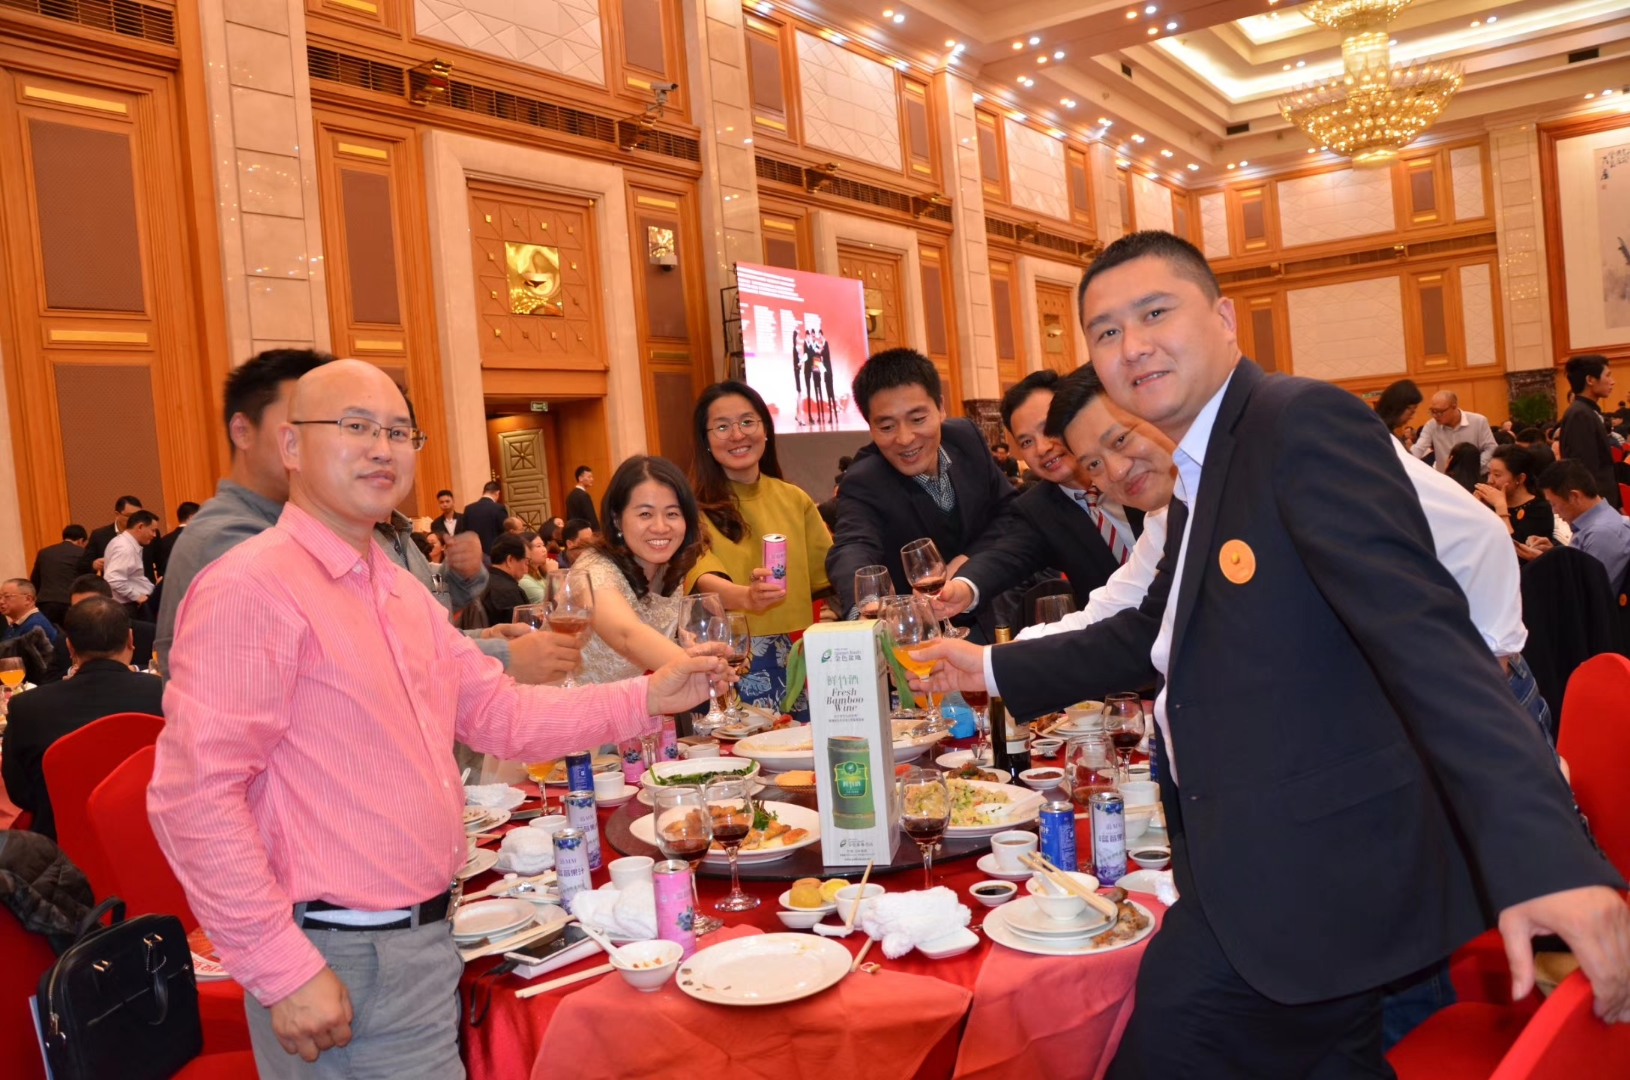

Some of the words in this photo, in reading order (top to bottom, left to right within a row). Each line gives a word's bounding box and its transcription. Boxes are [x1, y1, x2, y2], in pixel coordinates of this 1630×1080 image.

[831, 688, 857, 697] Fresh
[826, 696, 864, 706] Bamboo
[834, 704, 857, 712] Wine
